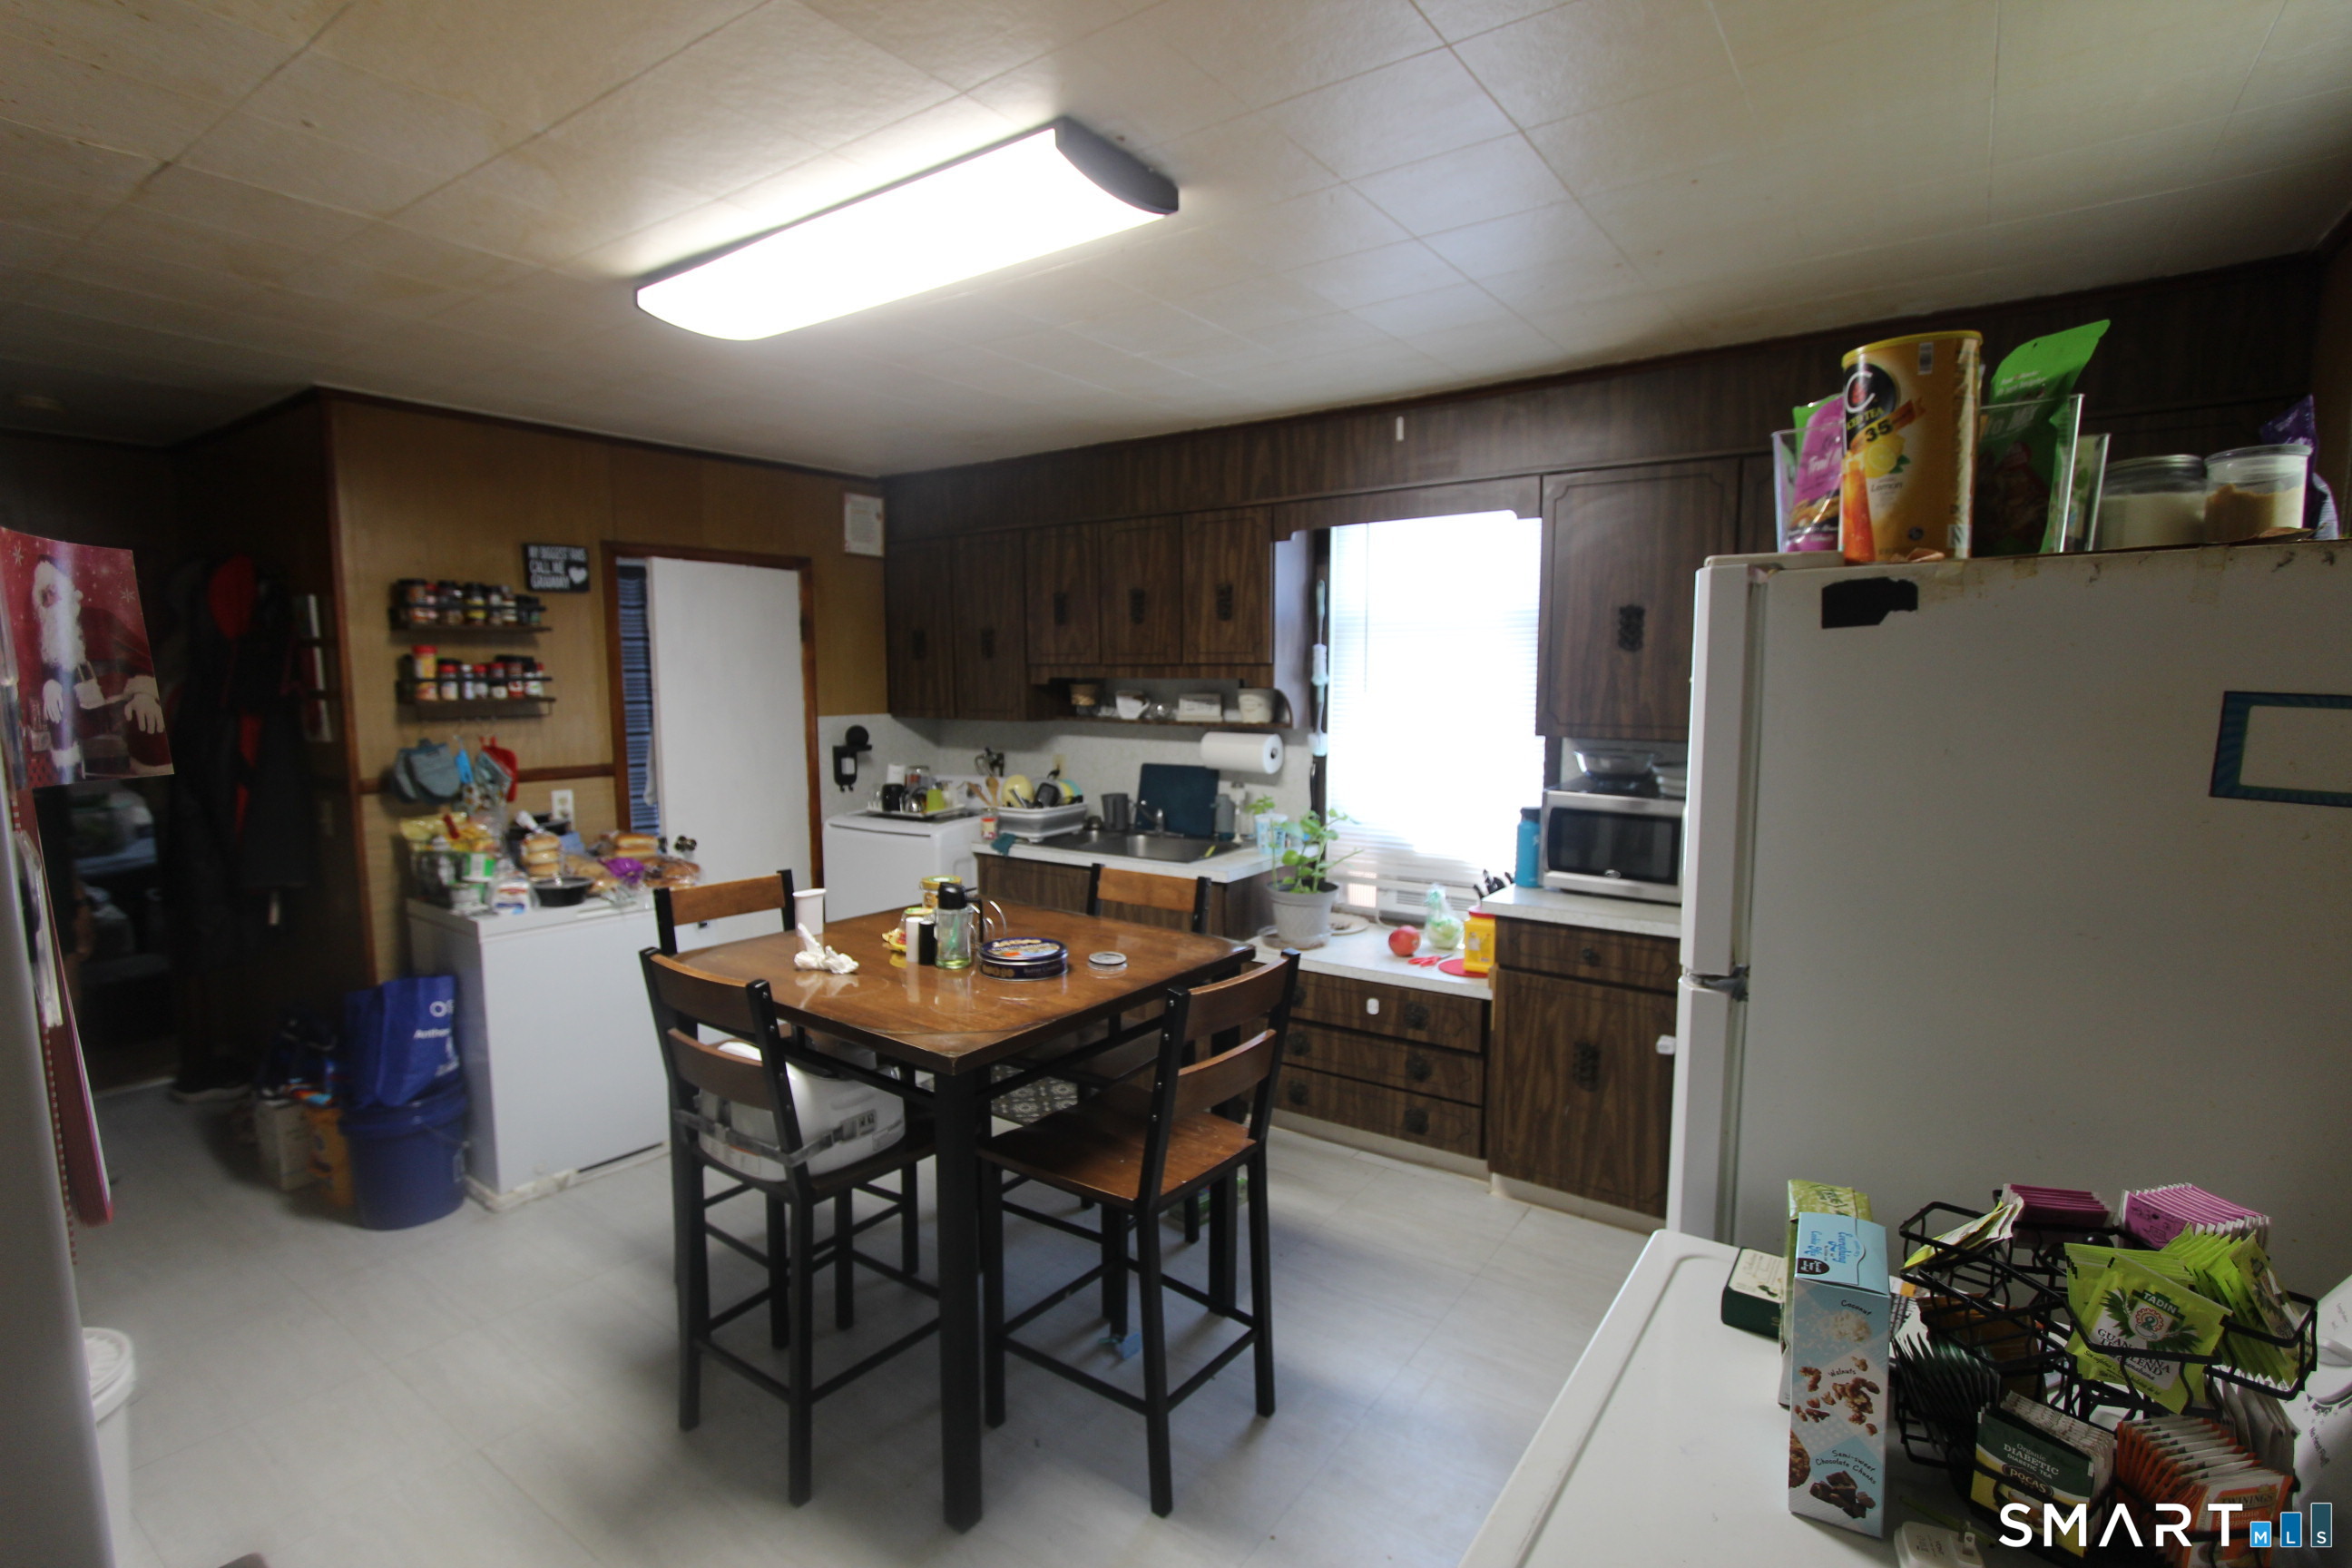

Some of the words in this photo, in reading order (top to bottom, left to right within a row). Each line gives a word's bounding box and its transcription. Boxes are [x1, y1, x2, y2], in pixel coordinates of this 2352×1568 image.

[1865, 407, 1886, 420] TEA
[1866, 420, 1893, 443] 35
[1870, 482, 1904, 493] Lemon
[1840, 1299, 1873, 1317] Coconut
[2143, 1291, 2178, 1315] TADIN
[1828, 1367, 1857, 1377] Walnuts
[2129, 1355, 2164, 1377] LEND
[1832, 1449, 1877, 1472] Semi-sweet
[2004, 1444, 2060, 1475] DIABETIC
[2016, 1443, 2047, 1461] Organic
[1815, 1458, 1850, 1467] Chocolate
[1852, 1465, 1877, 1485] Chunks
[2007, 1454, 2038, 1472] DIABETIC
[2040, 1470, 2053, 1479] TEA
[2010, 1467, 2047, 1494] POCAS
